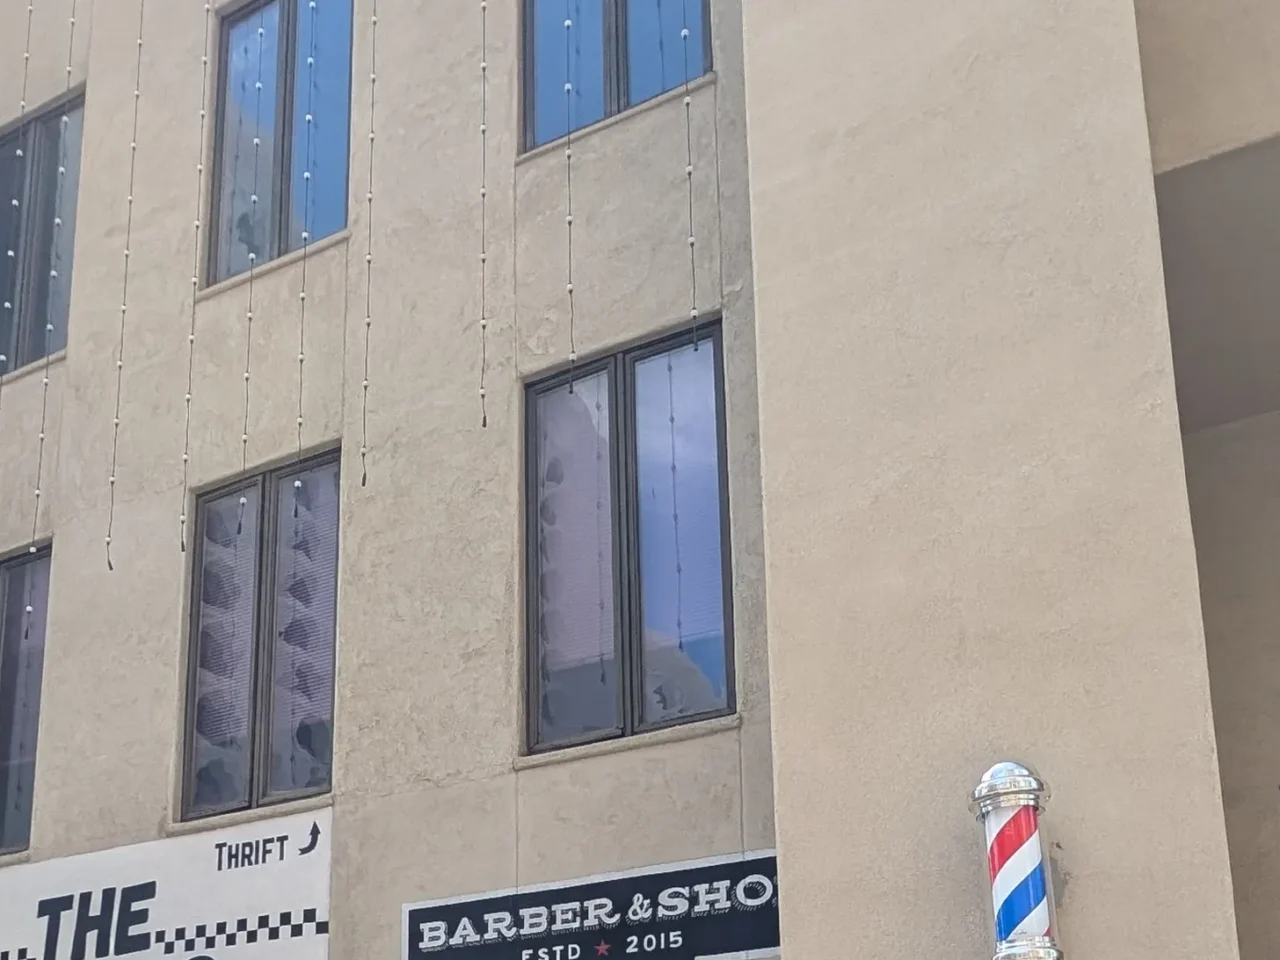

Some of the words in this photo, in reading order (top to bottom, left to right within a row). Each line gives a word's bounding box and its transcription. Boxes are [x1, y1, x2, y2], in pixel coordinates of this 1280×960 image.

[215, 835, 289, 870] THRIFT
[418, 898, 620, 949] BARBER
[625, 893, 653, 922] &
[656, 874, 778, 919] SHO
[625, 931, 683, 954] 2015
